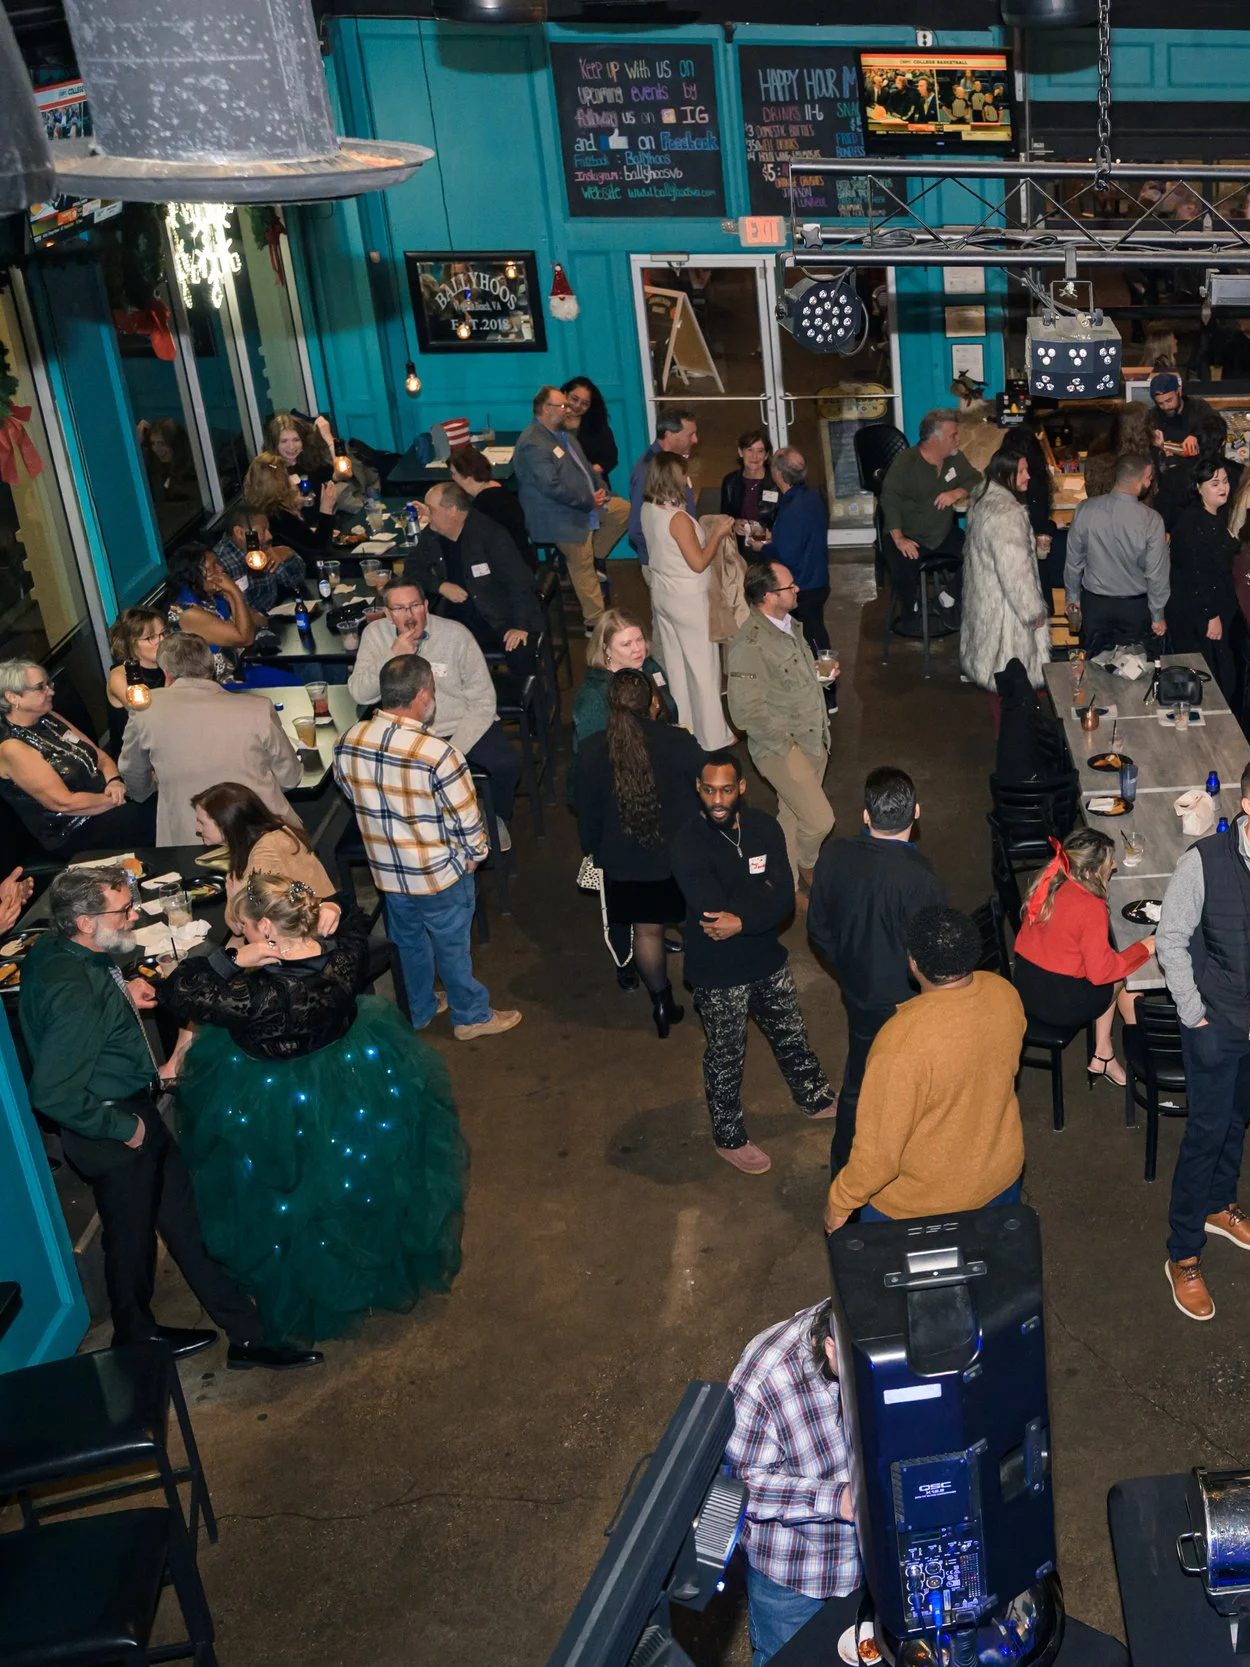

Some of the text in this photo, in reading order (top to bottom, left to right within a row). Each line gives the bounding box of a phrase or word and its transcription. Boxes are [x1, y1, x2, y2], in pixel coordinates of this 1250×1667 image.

[630, 83, 670, 103] events
[682, 82, 697, 100] by
[758, 68, 799, 101] HAPPY
[803, 68, 840, 100] HOUR
[680, 105, 709, 124] IG
[763, 105, 801, 122] DRINKS
[573, 133, 597, 151] and
[638, 135, 655, 150] on
[746, 217, 779, 243] EXIT
[435, 271, 517, 311] BALLYHOOS
[451, 318, 511, 332] ET.2018
[918, 1481, 952, 1492] QSC
